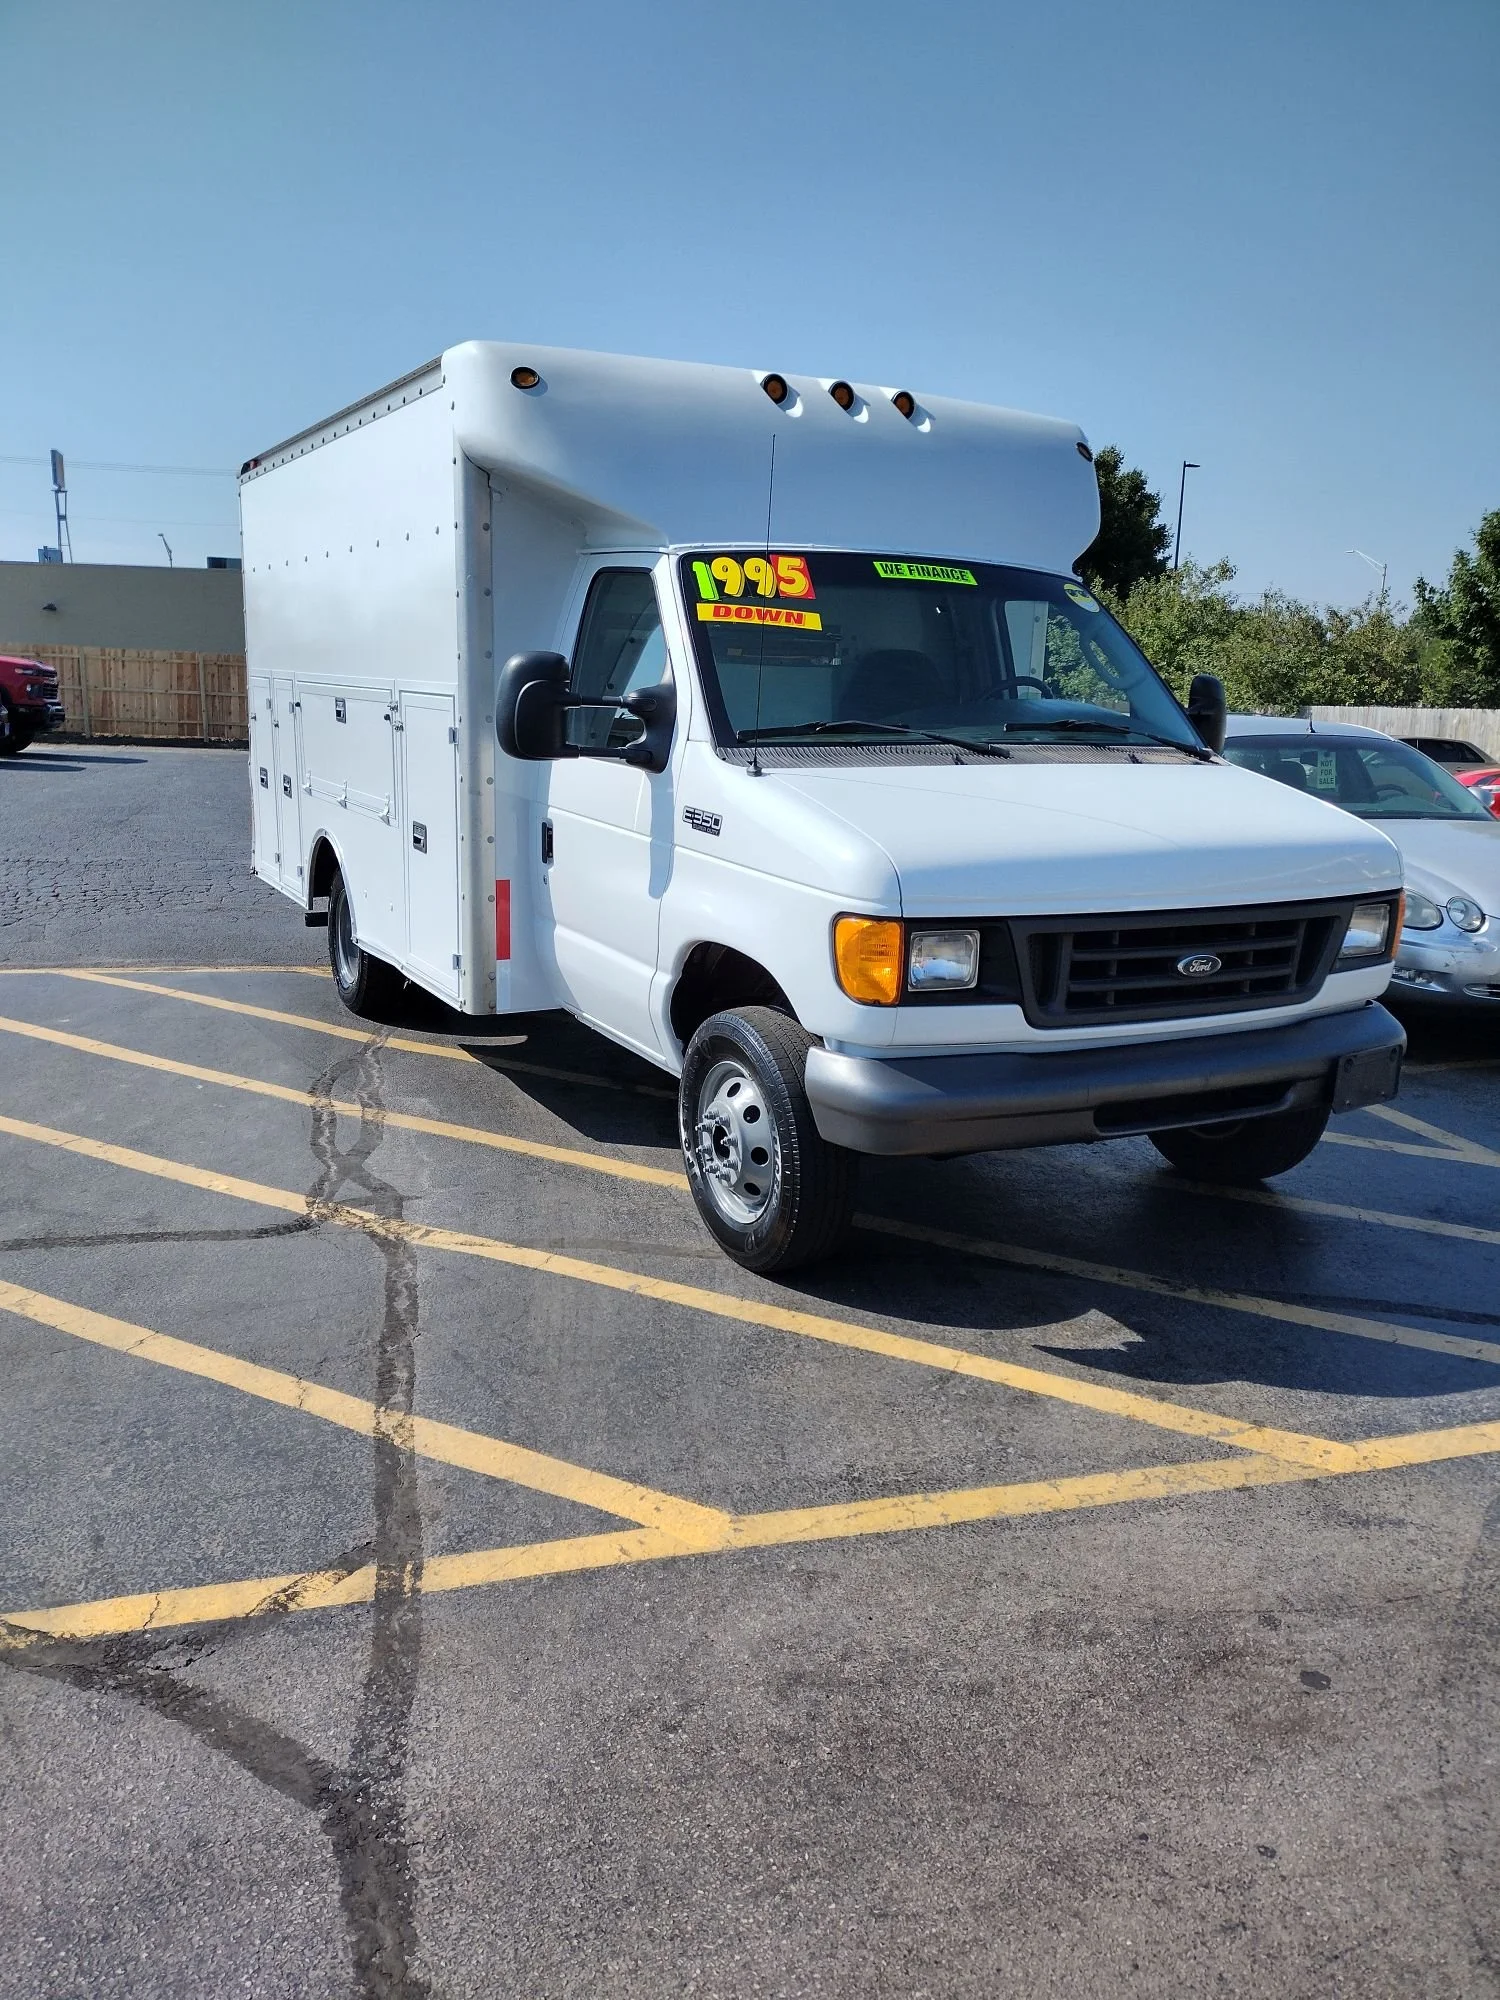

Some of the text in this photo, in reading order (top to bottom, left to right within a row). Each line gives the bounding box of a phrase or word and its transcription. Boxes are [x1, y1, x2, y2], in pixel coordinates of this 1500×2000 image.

[692, 556, 809, 600] 1995
[880, 562, 969, 581] WE FINANCE
[712, 605, 806, 626] DOWN
[1319, 777, 1335, 785] SALE
